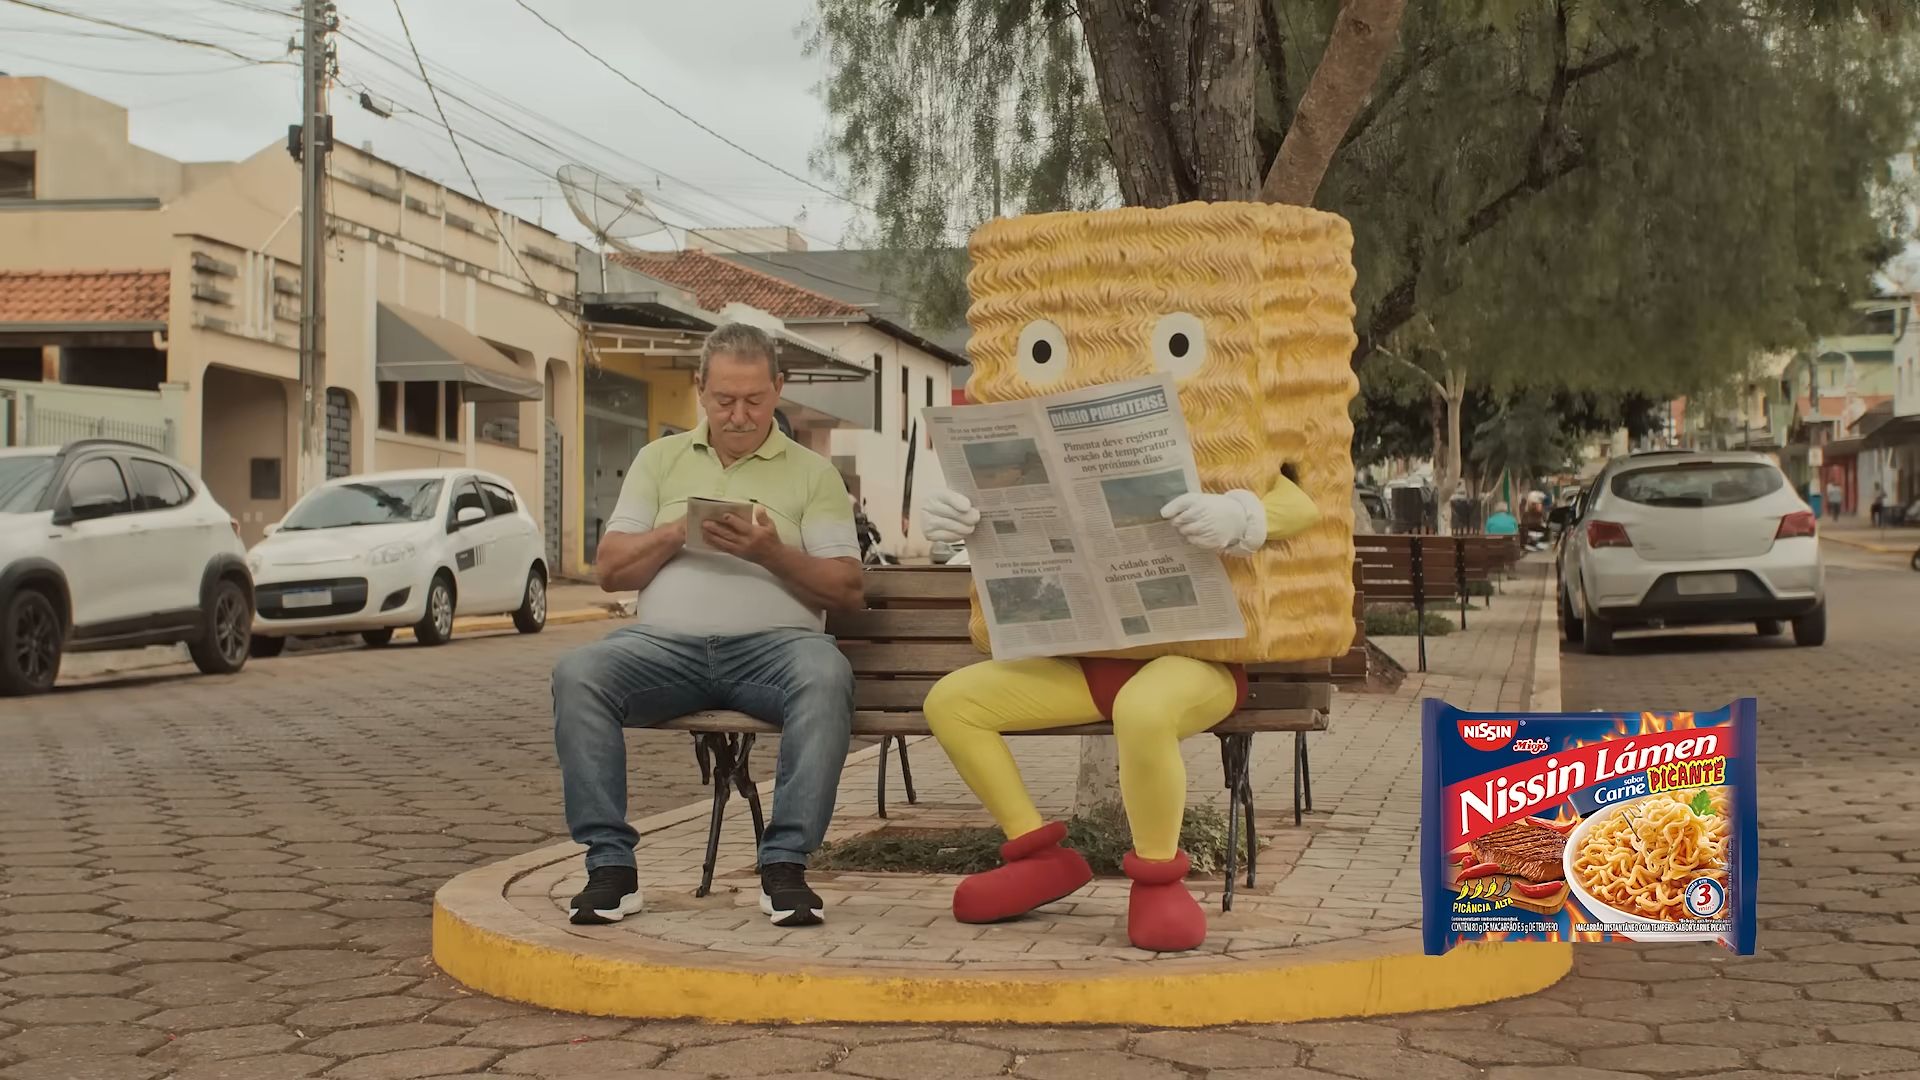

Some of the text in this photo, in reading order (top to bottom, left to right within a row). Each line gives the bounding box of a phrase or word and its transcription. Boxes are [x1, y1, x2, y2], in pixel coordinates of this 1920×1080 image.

[1050, 393, 1167, 427] DIÁRIO PIMENTENSE
[1063, 427, 1169, 452] Pimenta deve registrar
[1063, 440, 1177, 464] elevação de temperatura
[1081, 455, 1163, 473] nos próximos dias
[1110, 554, 1174, 571] A cidade mais
[1104, 563, 1186, 583] calorosa do Brasil
[1464, 722, 1512, 741] NISSIN
[1513, 739, 1548, 754] Miojo
[1459, 734, 1718, 836] Nissin Lámen
[1594, 756, 1725, 804] Carne PICANTE
[1624, 776, 1645, 785] sabor
[1697, 883, 1712, 906] 3
[1452, 897, 1514, 914] PICÂNCIA ALTA
[1451, 921, 1471, 931] CONTÉM
[1478, 924, 1483, 933] g
[1483, 922, 1490, 931] DE
[1490, 920, 1517, 931] MACARRÃO
[1525, 924, 1529, 933] g
[1529, 922, 1536, 931] DE
[1536, 922, 1559, 931] TEMPERO
[1575, 922, 1732, 931] MACARRÃO INSTANTÂNEO COM TEMPERO SABOR CARNE PICANTE
